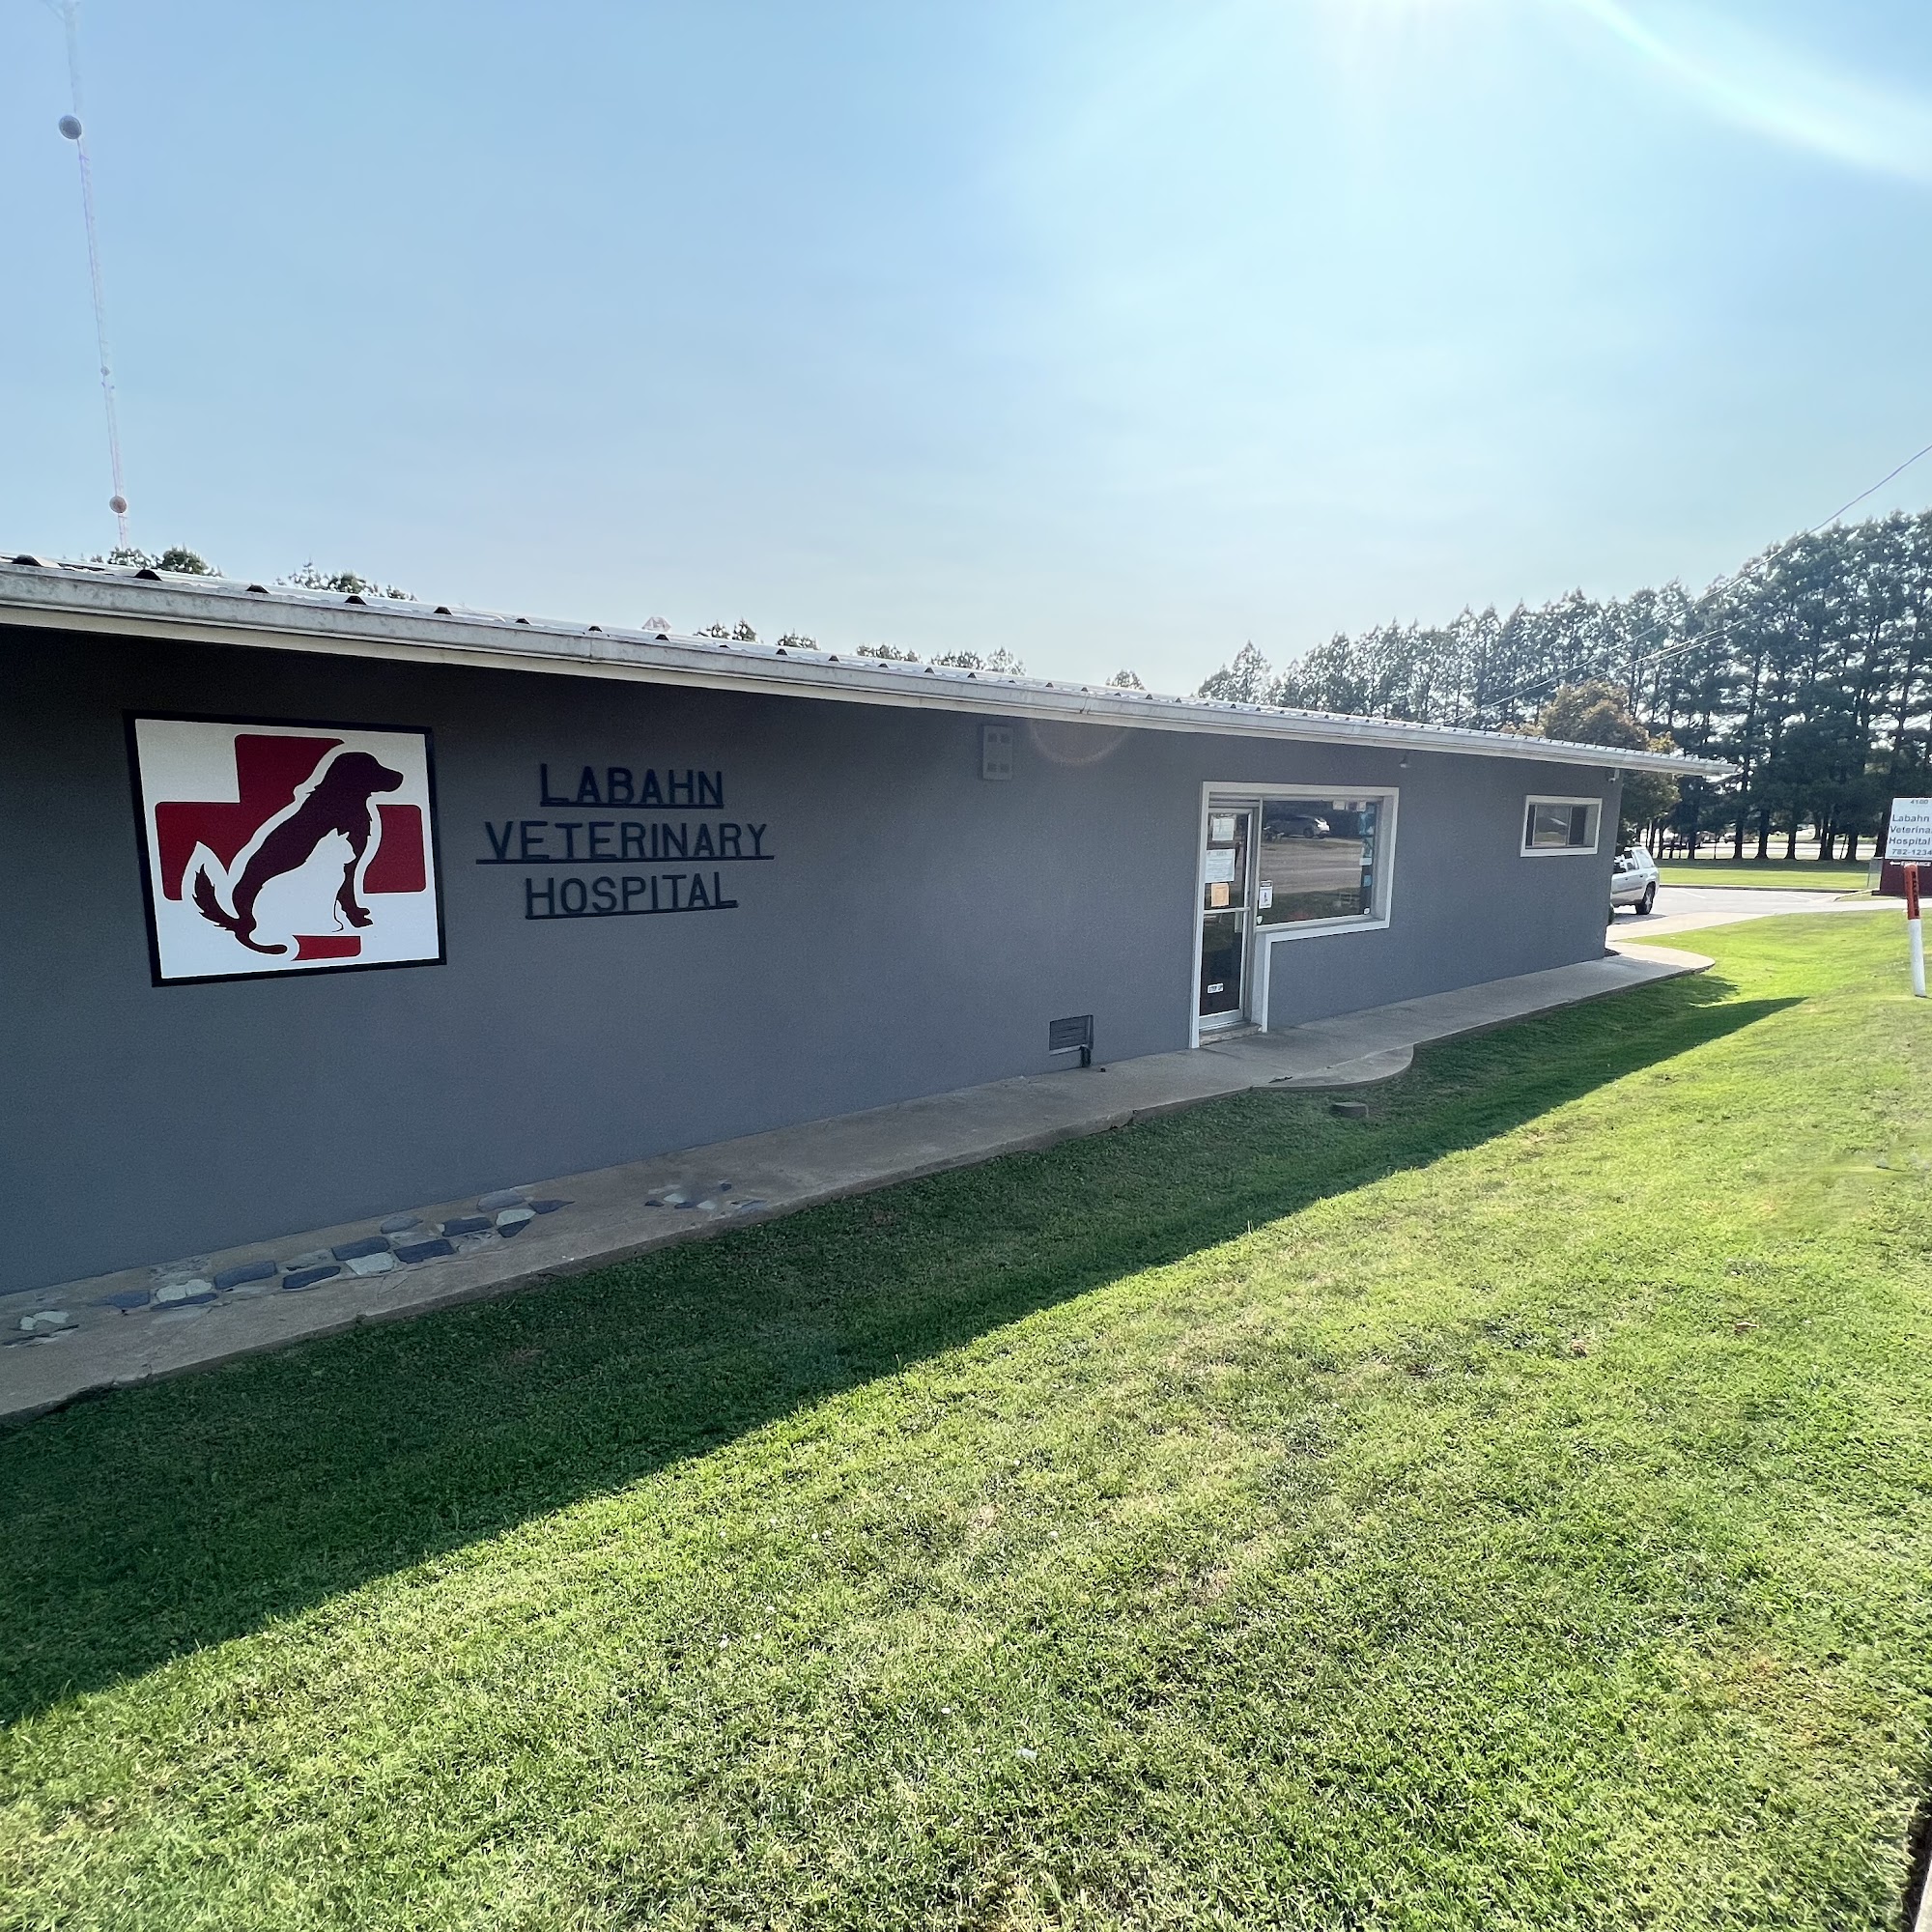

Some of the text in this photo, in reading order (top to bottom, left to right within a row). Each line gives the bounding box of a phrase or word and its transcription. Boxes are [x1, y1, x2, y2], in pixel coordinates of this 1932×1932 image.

[540, 763, 724, 809] LABAHN
[483, 820, 769, 862] VETERINARY
[1889, 825, 1932, 834] Veterina
[1889, 837, 1931, 846] Hospital
[525, 871, 738, 919] HOSPITAL
